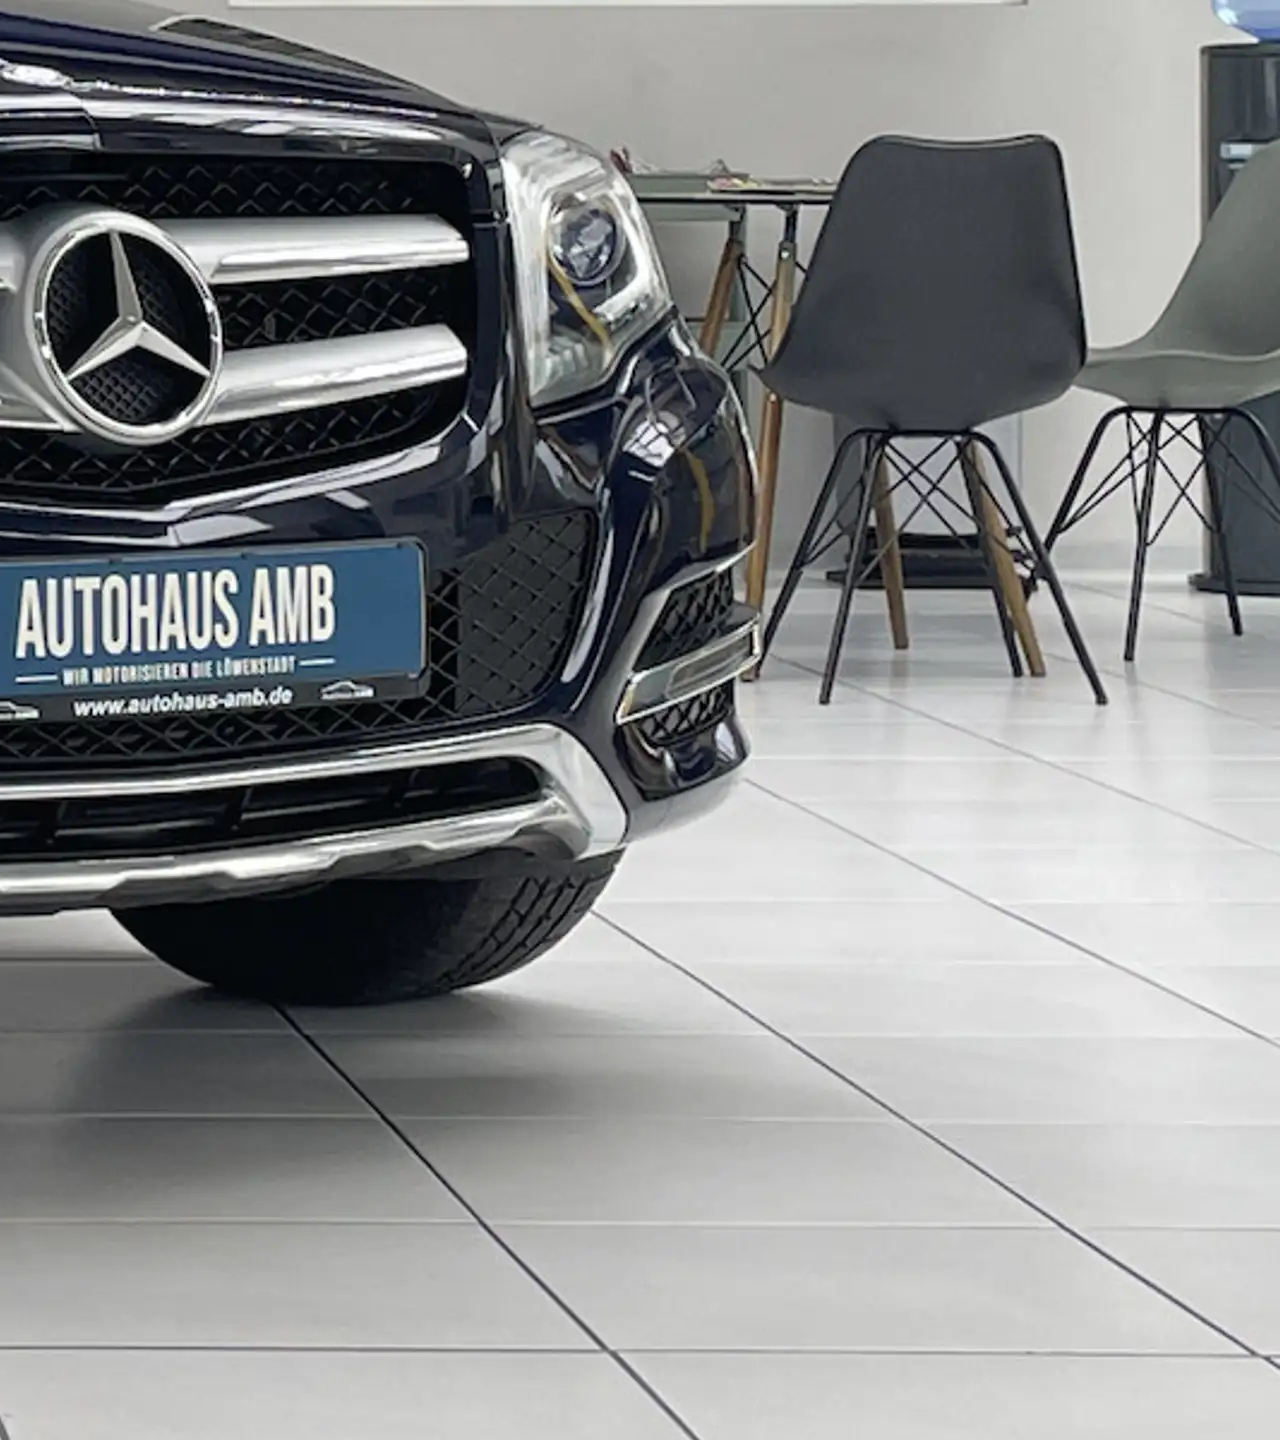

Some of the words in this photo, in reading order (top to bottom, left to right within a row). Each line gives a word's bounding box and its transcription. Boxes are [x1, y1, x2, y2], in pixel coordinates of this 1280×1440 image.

[15, 568, 239, 658] AUTOHAUS
[249, 563, 336, 646] AMB
[62, 666, 89, 686] WIR
[92, 661, 189, 685] MOTORISIEREN
[192, 659, 212, 679] DIE
[73, 686, 293, 717] www.autohaus-amb.de
